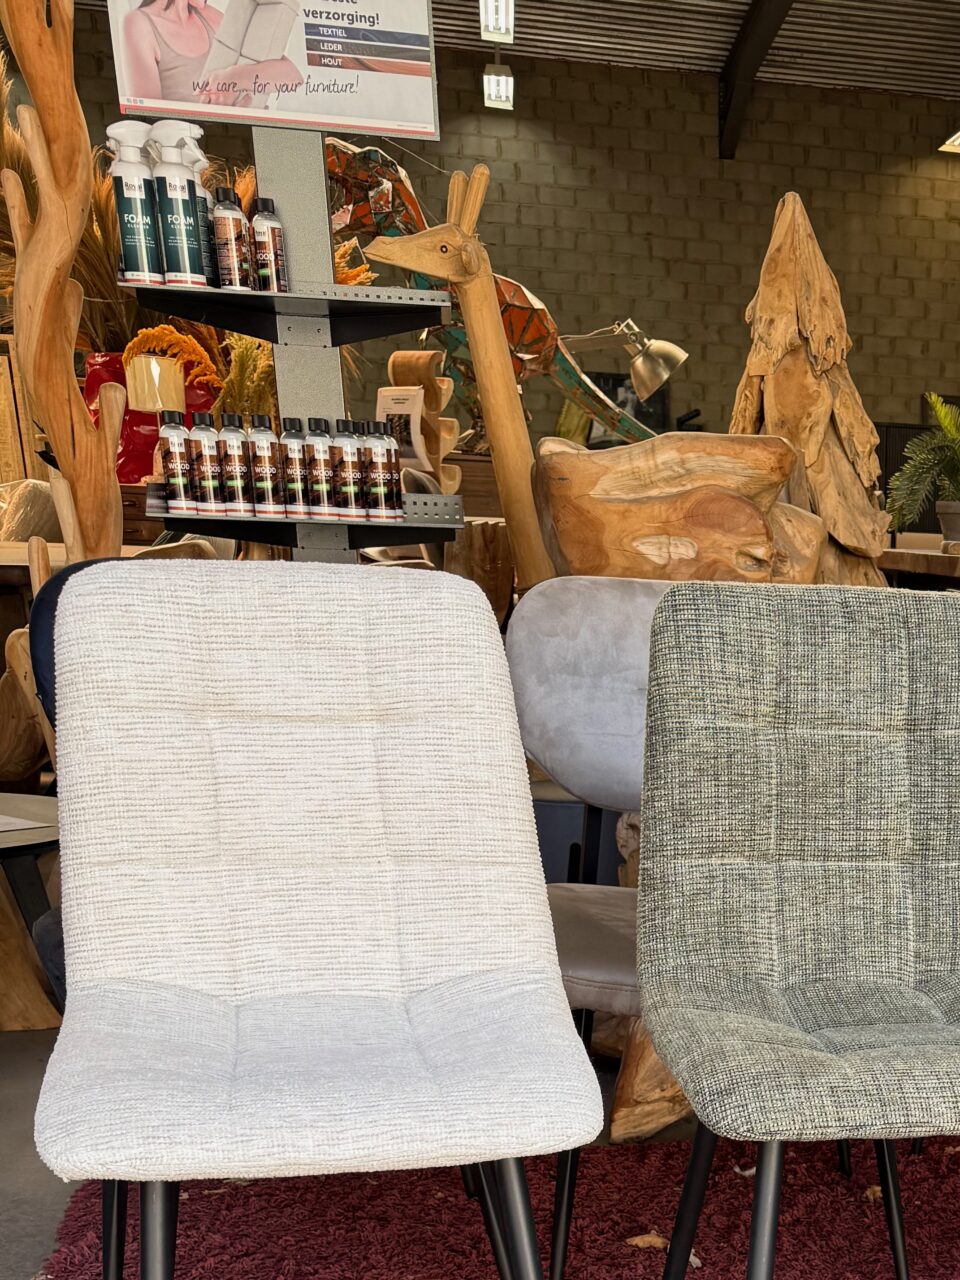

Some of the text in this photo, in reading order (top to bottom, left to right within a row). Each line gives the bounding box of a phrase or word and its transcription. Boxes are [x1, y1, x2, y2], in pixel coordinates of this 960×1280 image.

[303, 8, 380, 27] verzorging!
[318, 26, 348, 37] TEXTIEL
[320, 43, 343, 52] LEDER
[321, 57, 342, 66] HOUT
[192, 80, 209, 92] we
[253, 74, 271, 95] for
[274, 81, 301, 100] your
[305, 74, 360, 96] furniture!
[124, 213, 151, 225] FOAM
[167, 214, 195, 226] FOAM
[255, 466, 276, 474] WOOD
[312, 469, 333, 477] WOOD
